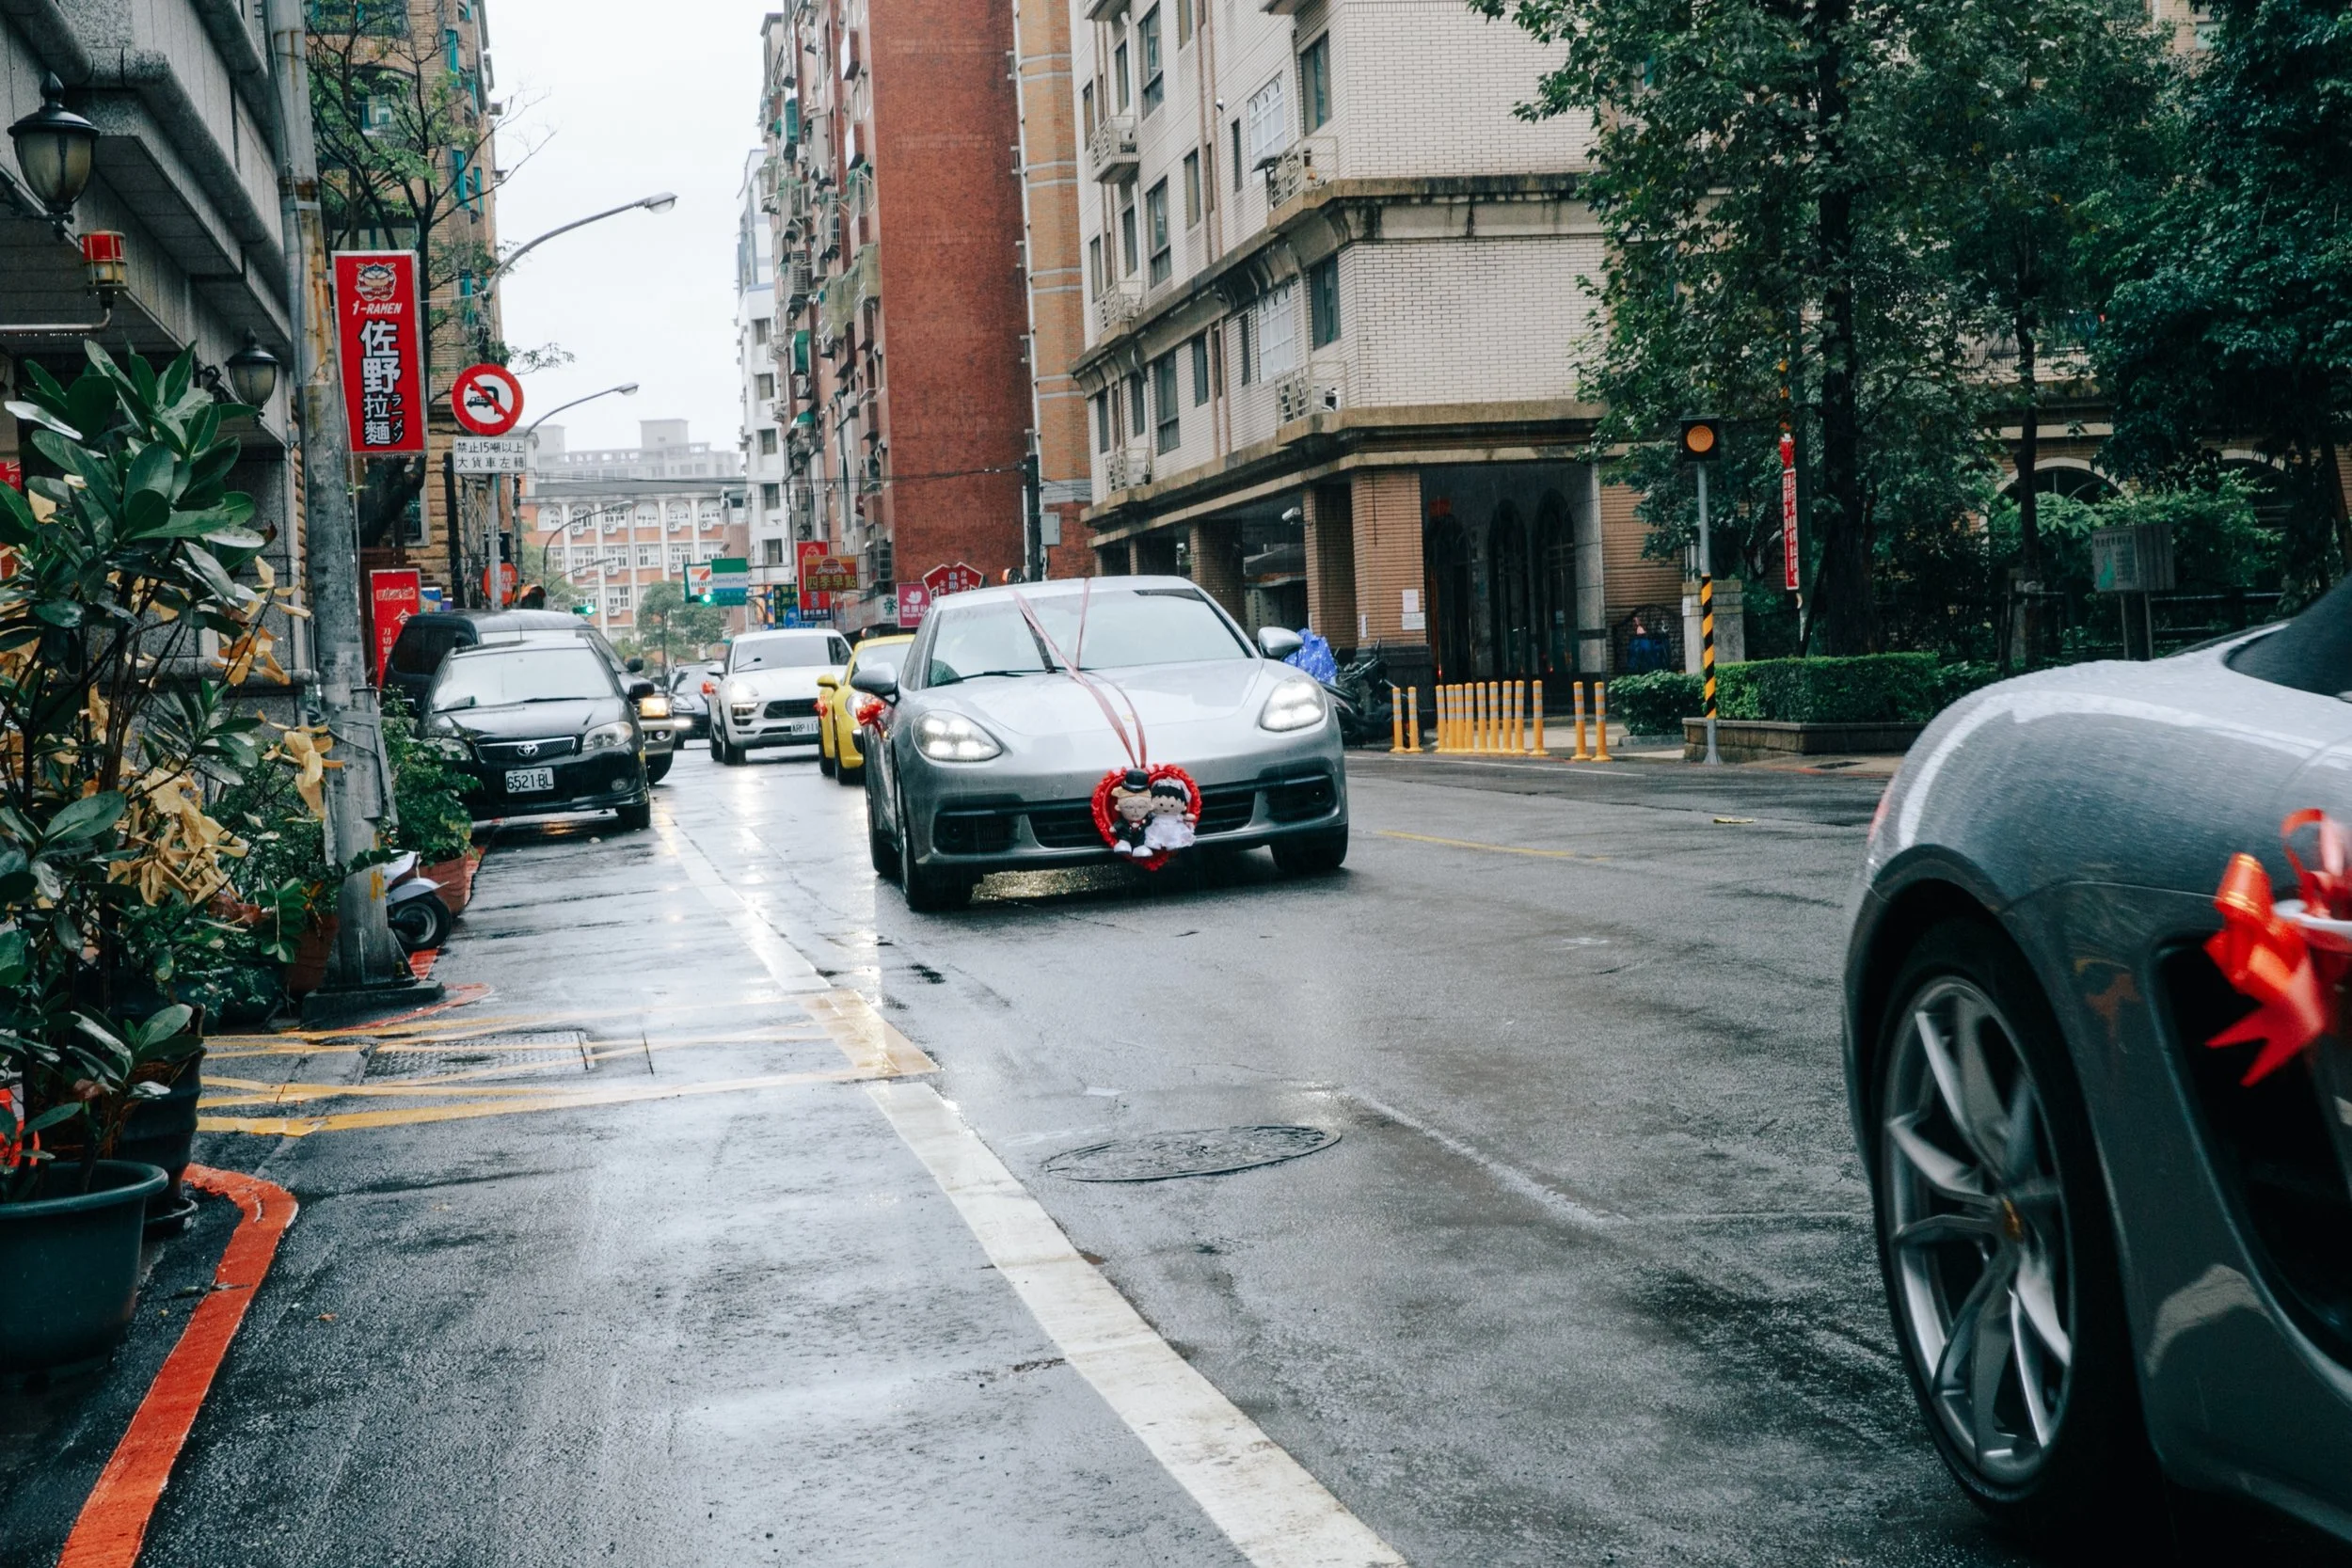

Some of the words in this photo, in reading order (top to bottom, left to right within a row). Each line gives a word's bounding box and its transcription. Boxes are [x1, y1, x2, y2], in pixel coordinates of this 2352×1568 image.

[359, 320, 402, 445] 佐野拉麵
[457, 456, 524, 469] 大貨車左轉
